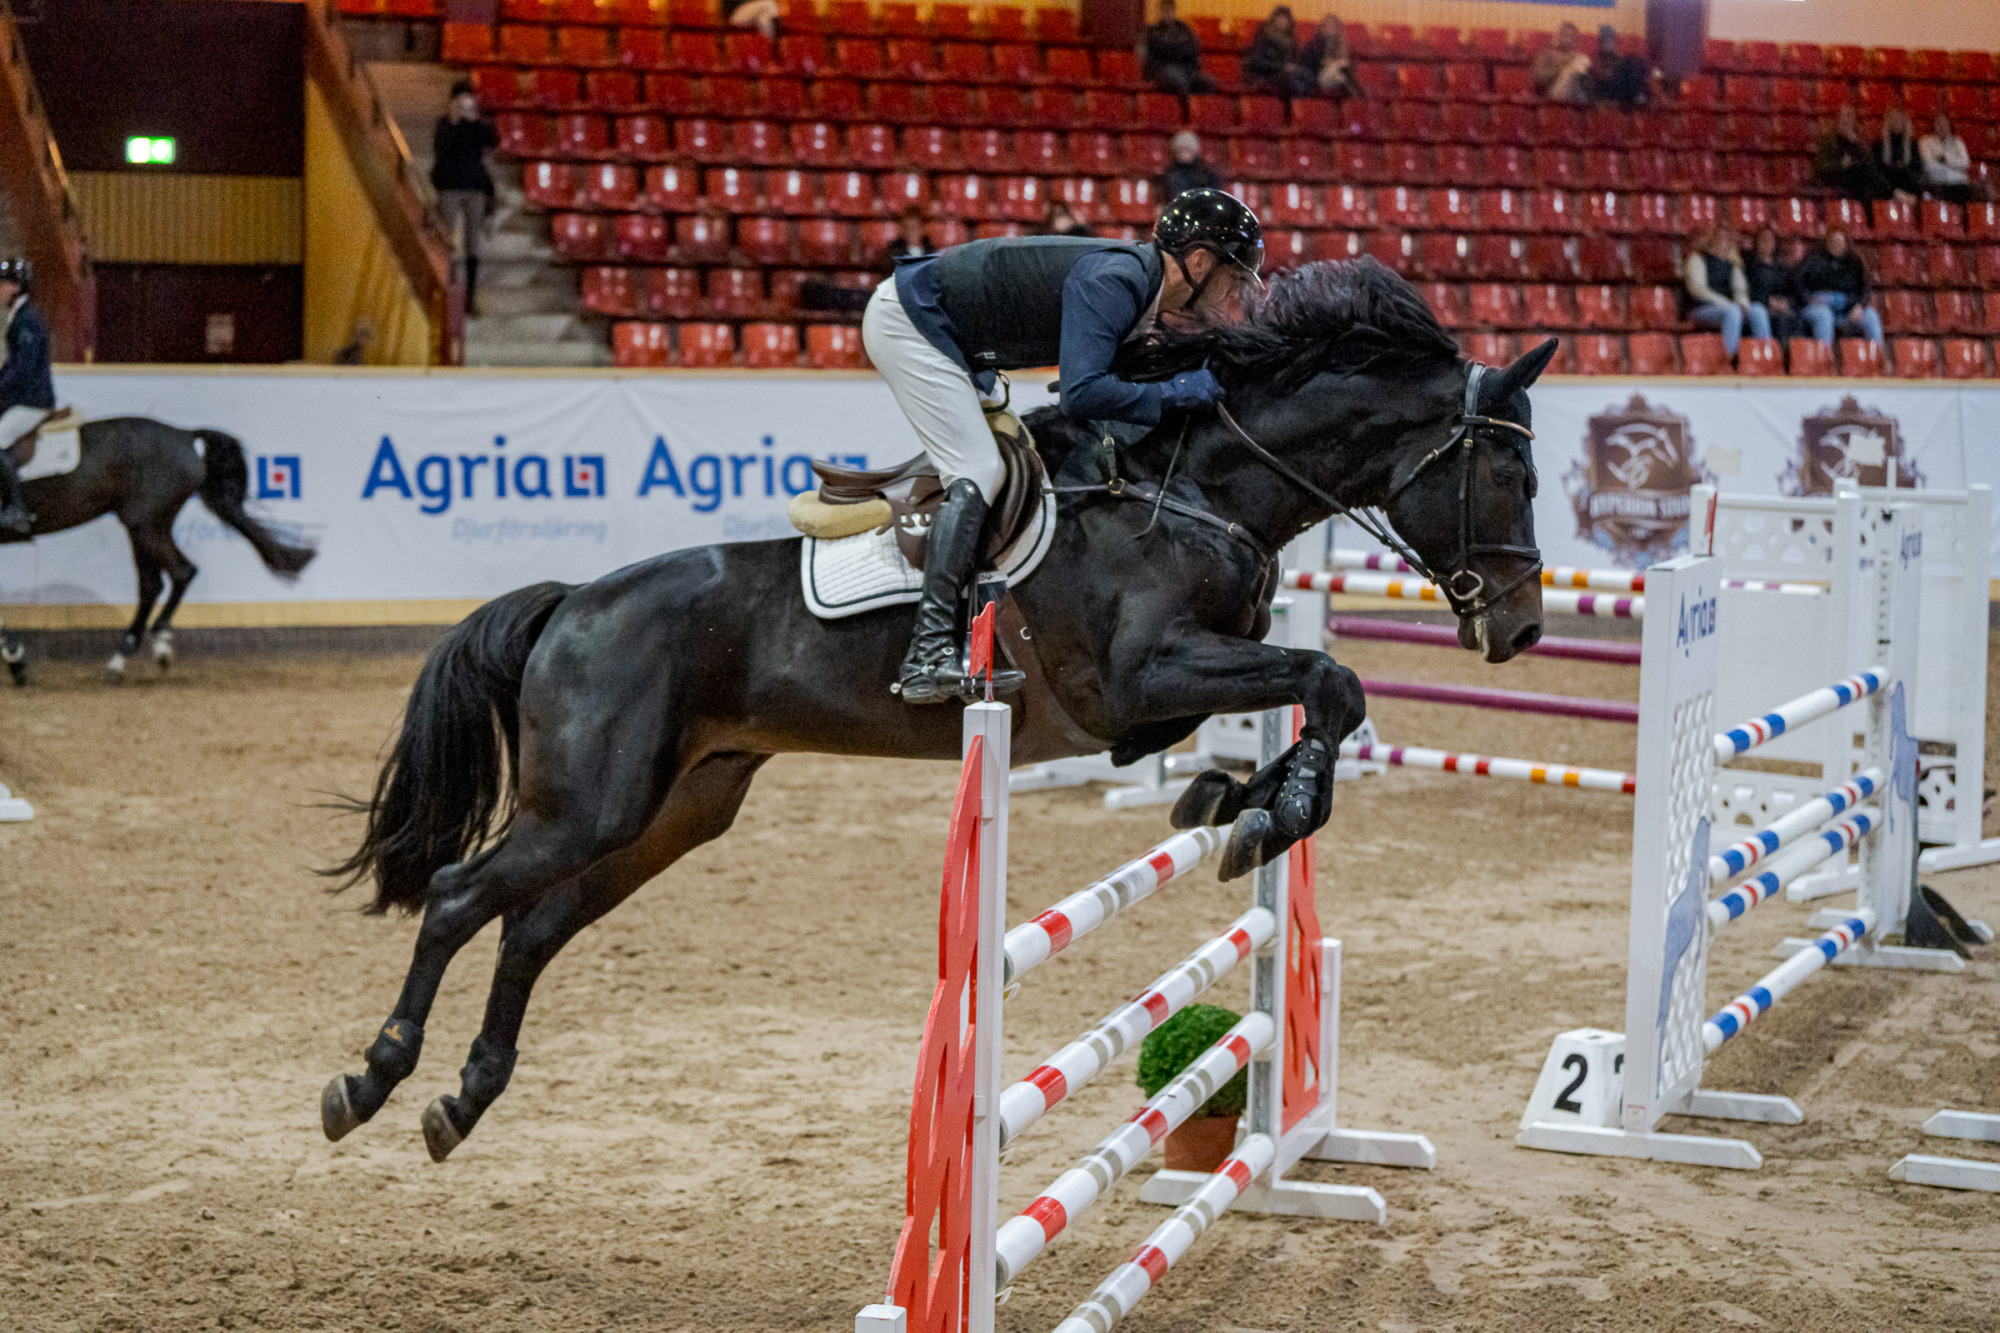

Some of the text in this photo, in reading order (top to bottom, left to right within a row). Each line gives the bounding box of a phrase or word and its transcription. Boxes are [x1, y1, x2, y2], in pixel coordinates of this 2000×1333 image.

[361, 434, 552, 515] Agria
[636, 434, 816, 513] Agria
[1553, 1053, 1588, 1114] 2
